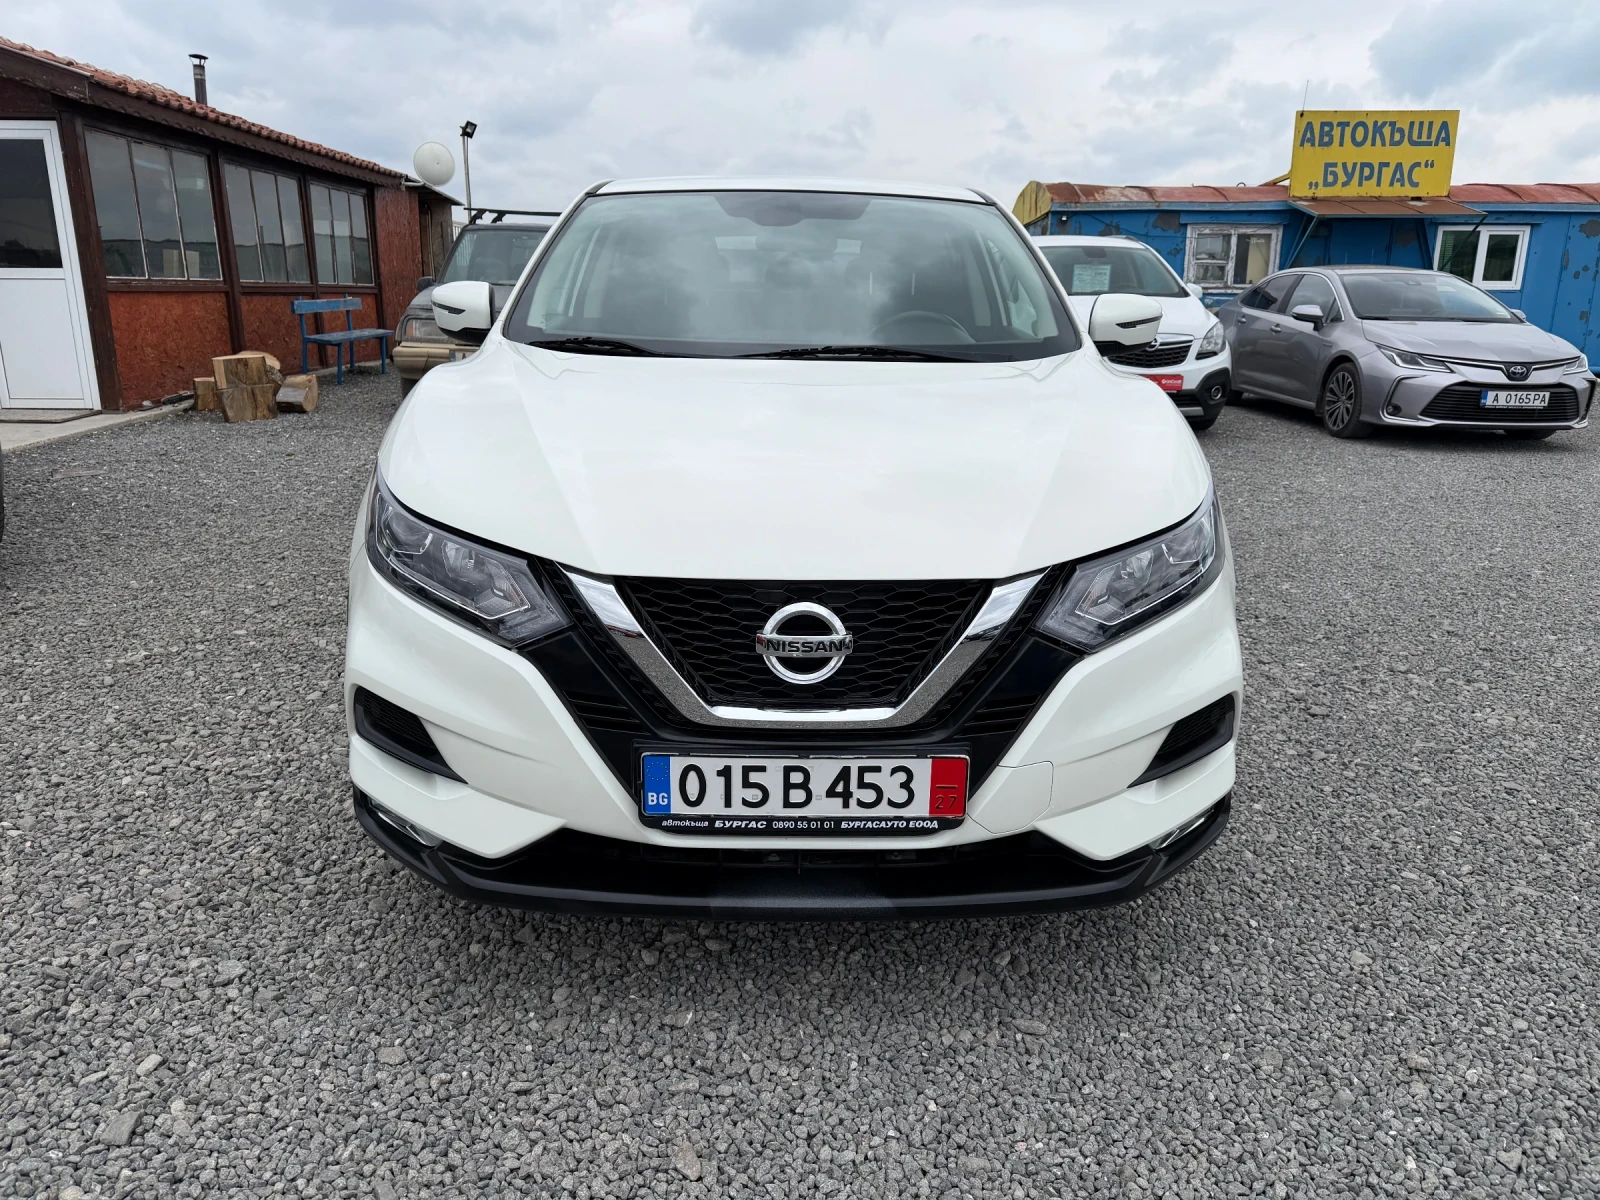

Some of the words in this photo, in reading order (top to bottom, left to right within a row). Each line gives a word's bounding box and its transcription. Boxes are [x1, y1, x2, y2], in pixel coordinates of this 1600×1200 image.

[1492, 393, 1499, 404] A
[766, 640, 842, 653] NISSAN
[647, 792, 669, 805] BG
[935, 794, 958, 809] 27
[714, 820, 767, 829] БУРГАС
[772, 821, 795, 829] 0890
[797, 821, 808, 829] 55
[810, 821, 821, 829] 01
[824, 821, 834, 829] 01
[840, 821, 907, 829] БУРГАСАУТО
[908, 820, 939, 829] ЕООД
